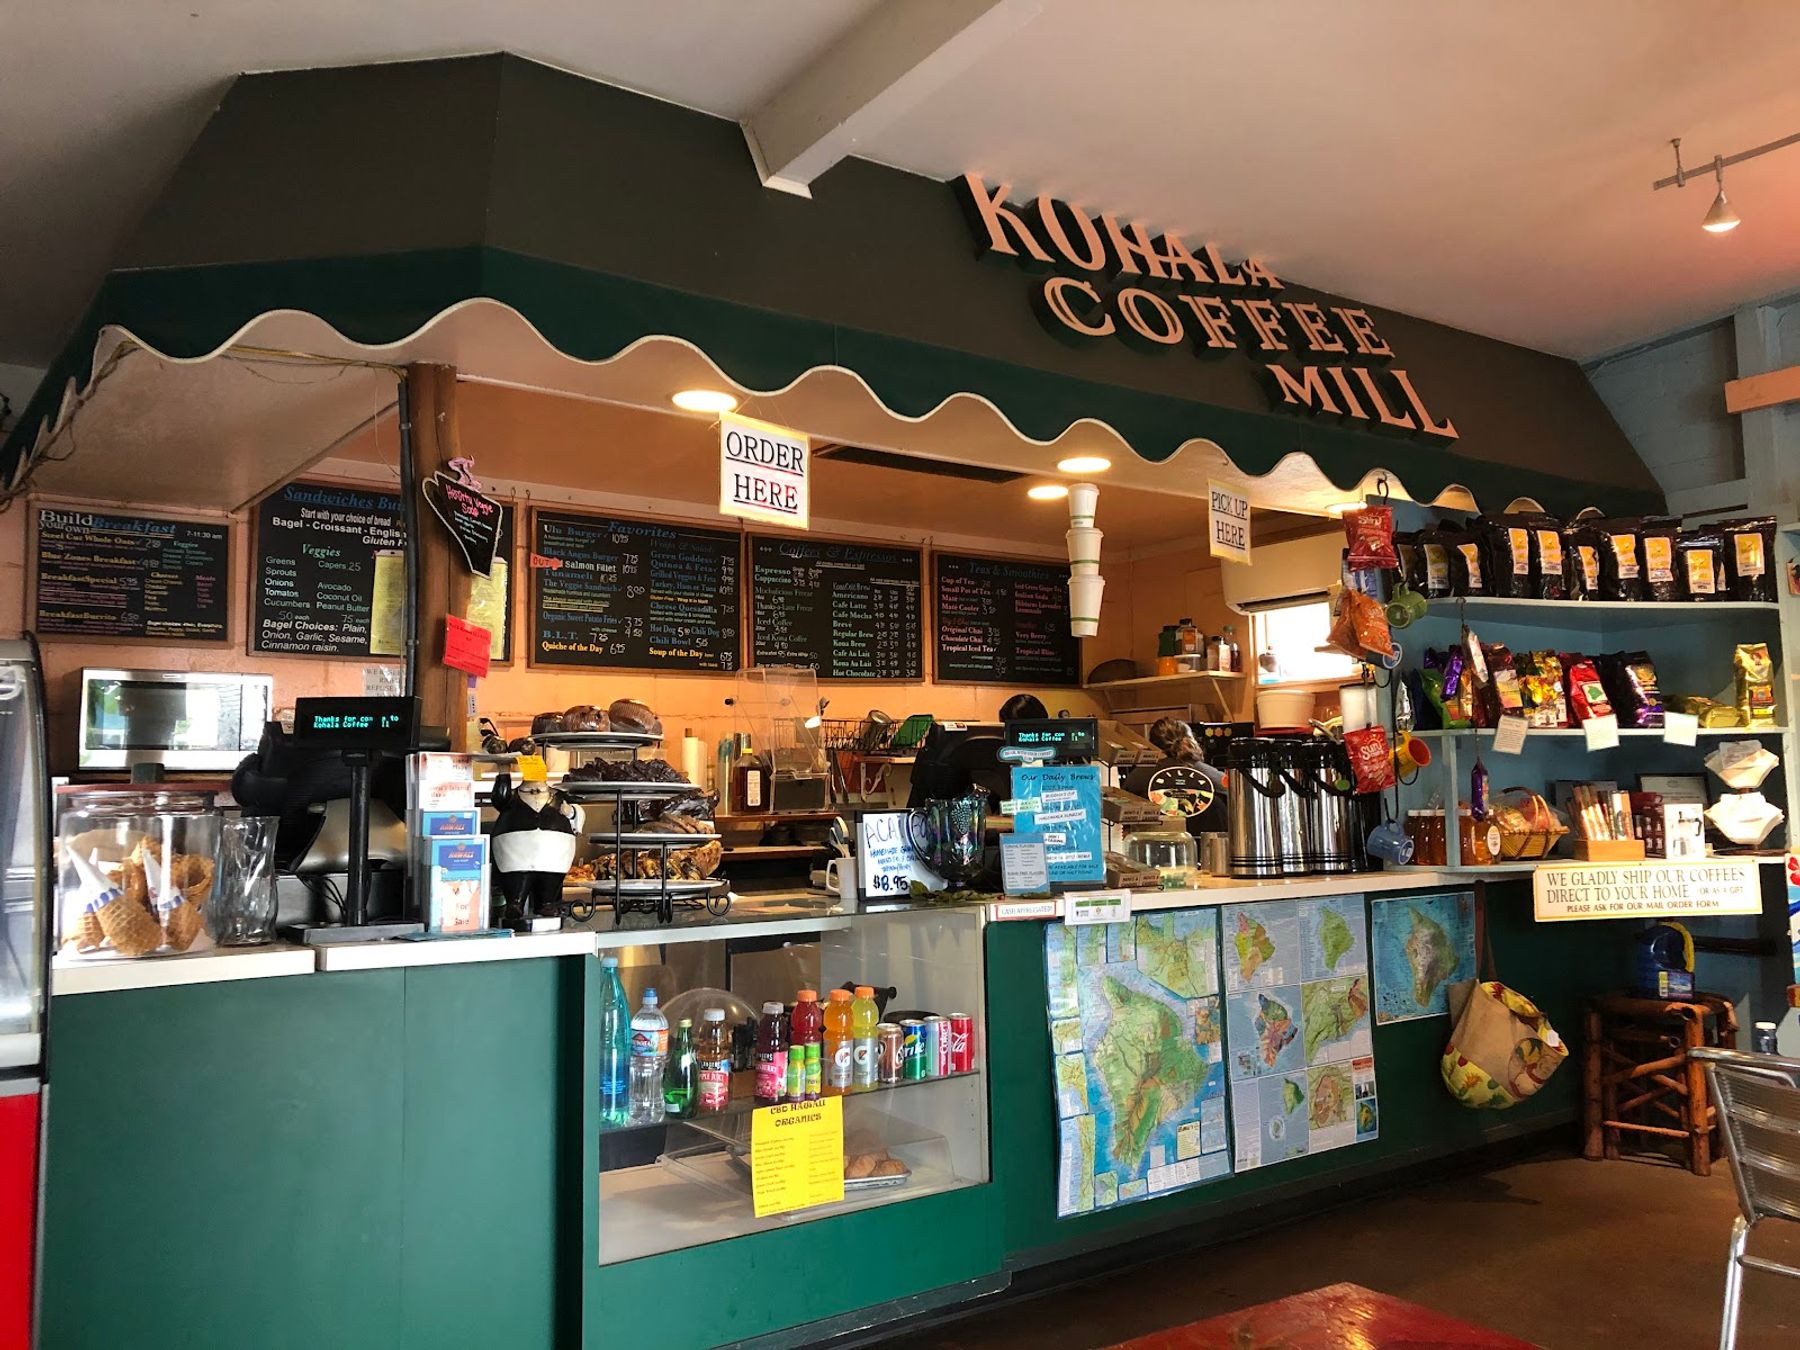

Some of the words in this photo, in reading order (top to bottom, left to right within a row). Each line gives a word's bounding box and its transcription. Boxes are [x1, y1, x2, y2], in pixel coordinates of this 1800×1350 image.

[963, 173, 1286, 291] KOHALA
[1043, 275, 1396, 360] COFFEE
[1265, 363, 1460, 441] MILL
[726, 430, 804, 474] ORDER
[283, 486, 374, 509] Sandwiches
[734, 473, 798, 510] HERE
[1211, 490, 1233, 514] PICK
[1234, 498, 1248, 518] UP
[40, 509, 93, 526] Build
[300, 506, 316, 519] Start
[316, 509, 330, 521] with
[330, 511, 346, 523] your
[345, 513, 367, 525] choice
[366, 515, 373, 526] of
[373, 515, 392, 527] bread
[65, 524, 90, 534] own
[93, 516, 176, 534] Breakfast
[272, 516, 303, 529] Bagel
[311, 520, 363, 535] Croissant
[543, 523, 562, 534] Ulu
[567, 526, 603, 539] Burger
[606, 520, 678, 539] Favorites
[84, 533, 112, 543] Whole
[1216, 519, 1246, 547] HERE
[362, 535, 395, 547] Gluten
[301, 542, 342, 559] Veggies
[543, 546, 565, 557] Black
[567, 549, 591, 561] Angus
[592, 551, 621, 563] Burger
[650, 549, 677, 561] Green
[93, 554, 137, 565] Breakfast
[265, 555, 297, 566] Greens
[317, 559, 347, 571] Capers
[532, 555, 550, 567] OUT
[564, 559, 596, 571] Salmon
[595, 562, 618, 573] Fillet
[265, 566, 298, 577] Sprouts
[754, 564, 793, 575] Espresso
[264, 577, 295, 587] Onions
[317, 581, 352, 592] Avocado
[543, 578, 559, 588] The
[559, 579, 584, 591] Veggie
[754, 573, 794, 584] Cappuccino
[941, 575, 955, 586] Cup
[961, 577, 977, 586] Tea
[316, 591, 350, 601] Coconut
[350, 593, 363, 602] Oil
[832, 591, 869, 601] Americano
[941, 585, 960, 594] Small
[263, 597, 311, 609] Cucumbers
[316, 600, 346, 611] Peanut
[345, 602, 370, 613] Butter
[650, 601, 678, 611] Cheese
[677, 603, 718, 614] Quesadilla
[848, 601, 868, 610] Latte
[957, 603, 980, 612] Cooler
[542, 610, 567, 623] Organic
[566, 613, 585, 623] Sweet
[603, 613, 618, 625] Fries
[756, 617, 771, 626] Iced
[771, 618, 793, 628] Coffee
[849, 611, 873, 620] Mocha
[262, 618, 293, 630] Bagel
[294, 620, 340, 633] Choices:
[341, 622, 369, 635] Plain,
[650, 623, 664, 633] Hot
[663, 624, 677, 637] Dog
[690, 626, 707, 636] Chili
[707, 627, 721, 640] Dog
[941, 624, 968, 636] Original
[967, 626, 984, 635] Chai
[295, 631, 327, 643] Garlic,
[327, 633, 369, 645] Sesame,
[649, 635, 670, 646] Chili
[671, 636, 691, 646] Bowl
[832, 629, 858, 639] Regular
[857, 631, 875, 639] Brew
[968, 635, 984, 644] Chai
[260, 639, 311, 650] Cinnamon
[541, 640, 568, 653] Quiche
[567, 642, 578, 651] of
[577, 642, 589, 652] the
[589, 643, 605, 655] Day
[832, 640, 850, 648] Kona
[849, 640, 868, 648] Brew
[941, 643, 968, 654] Tropical
[967, 644, 982, 653] Iced
[981, 644, 995, 653] Tea
[648, 646, 668, 659] Soup
[668, 648, 677, 657] of
[676, 648, 690, 658] the
[689, 649, 704, 661] Day
[832, 659, 850, 667] Kona
[832, 668, 845, 677] Hot
[845, 669, 878, 679] Chocolate
[312, 721, 341, 730] Kohala
[342, 721, 370, 729] Coffee
[343, 715, 358, 723] for
[1361, 740, 1383, 761] Sun
[1021, 774, 1039, 782] Our
[1042, 772, 1067, 783] Daily
[1070, 772, 1097, 781] Brews
[872, 874, 910, 892] $8.95
[1545, 871, 1569, 887] WE
[1570, 869, 1618, 887] GLADLY
[1622, 868, 1653, 886] SHIP
[1655, 867, 1687, 884] OUR
[1688, 866, 1746, 883] COFFEES
[1545, 887, 1591, 905] DIRECT
[1593, 886, 1613, 903] TO
[1613, 885, 1650, 902] YOUR
[1651, 884, 1691, 900] HOME
[1566, 903, 1592, 914] PLEASE
[1592, 903, 1608, 913] ASK
[1608, 902, 1625, 912] FOR
[1625, 901, 1644, 911] OUR
[1648, 901, 1666, 911] MAIL
[1665, 900, 1694, 910] ORDER
[1695, 899, 1721, 909] FORM
[770, 1104, 789, 1115] CBD
[789, 1098, 828, 1113] HAWAII
[774, 1112, 823, 1128] ORGANICS
